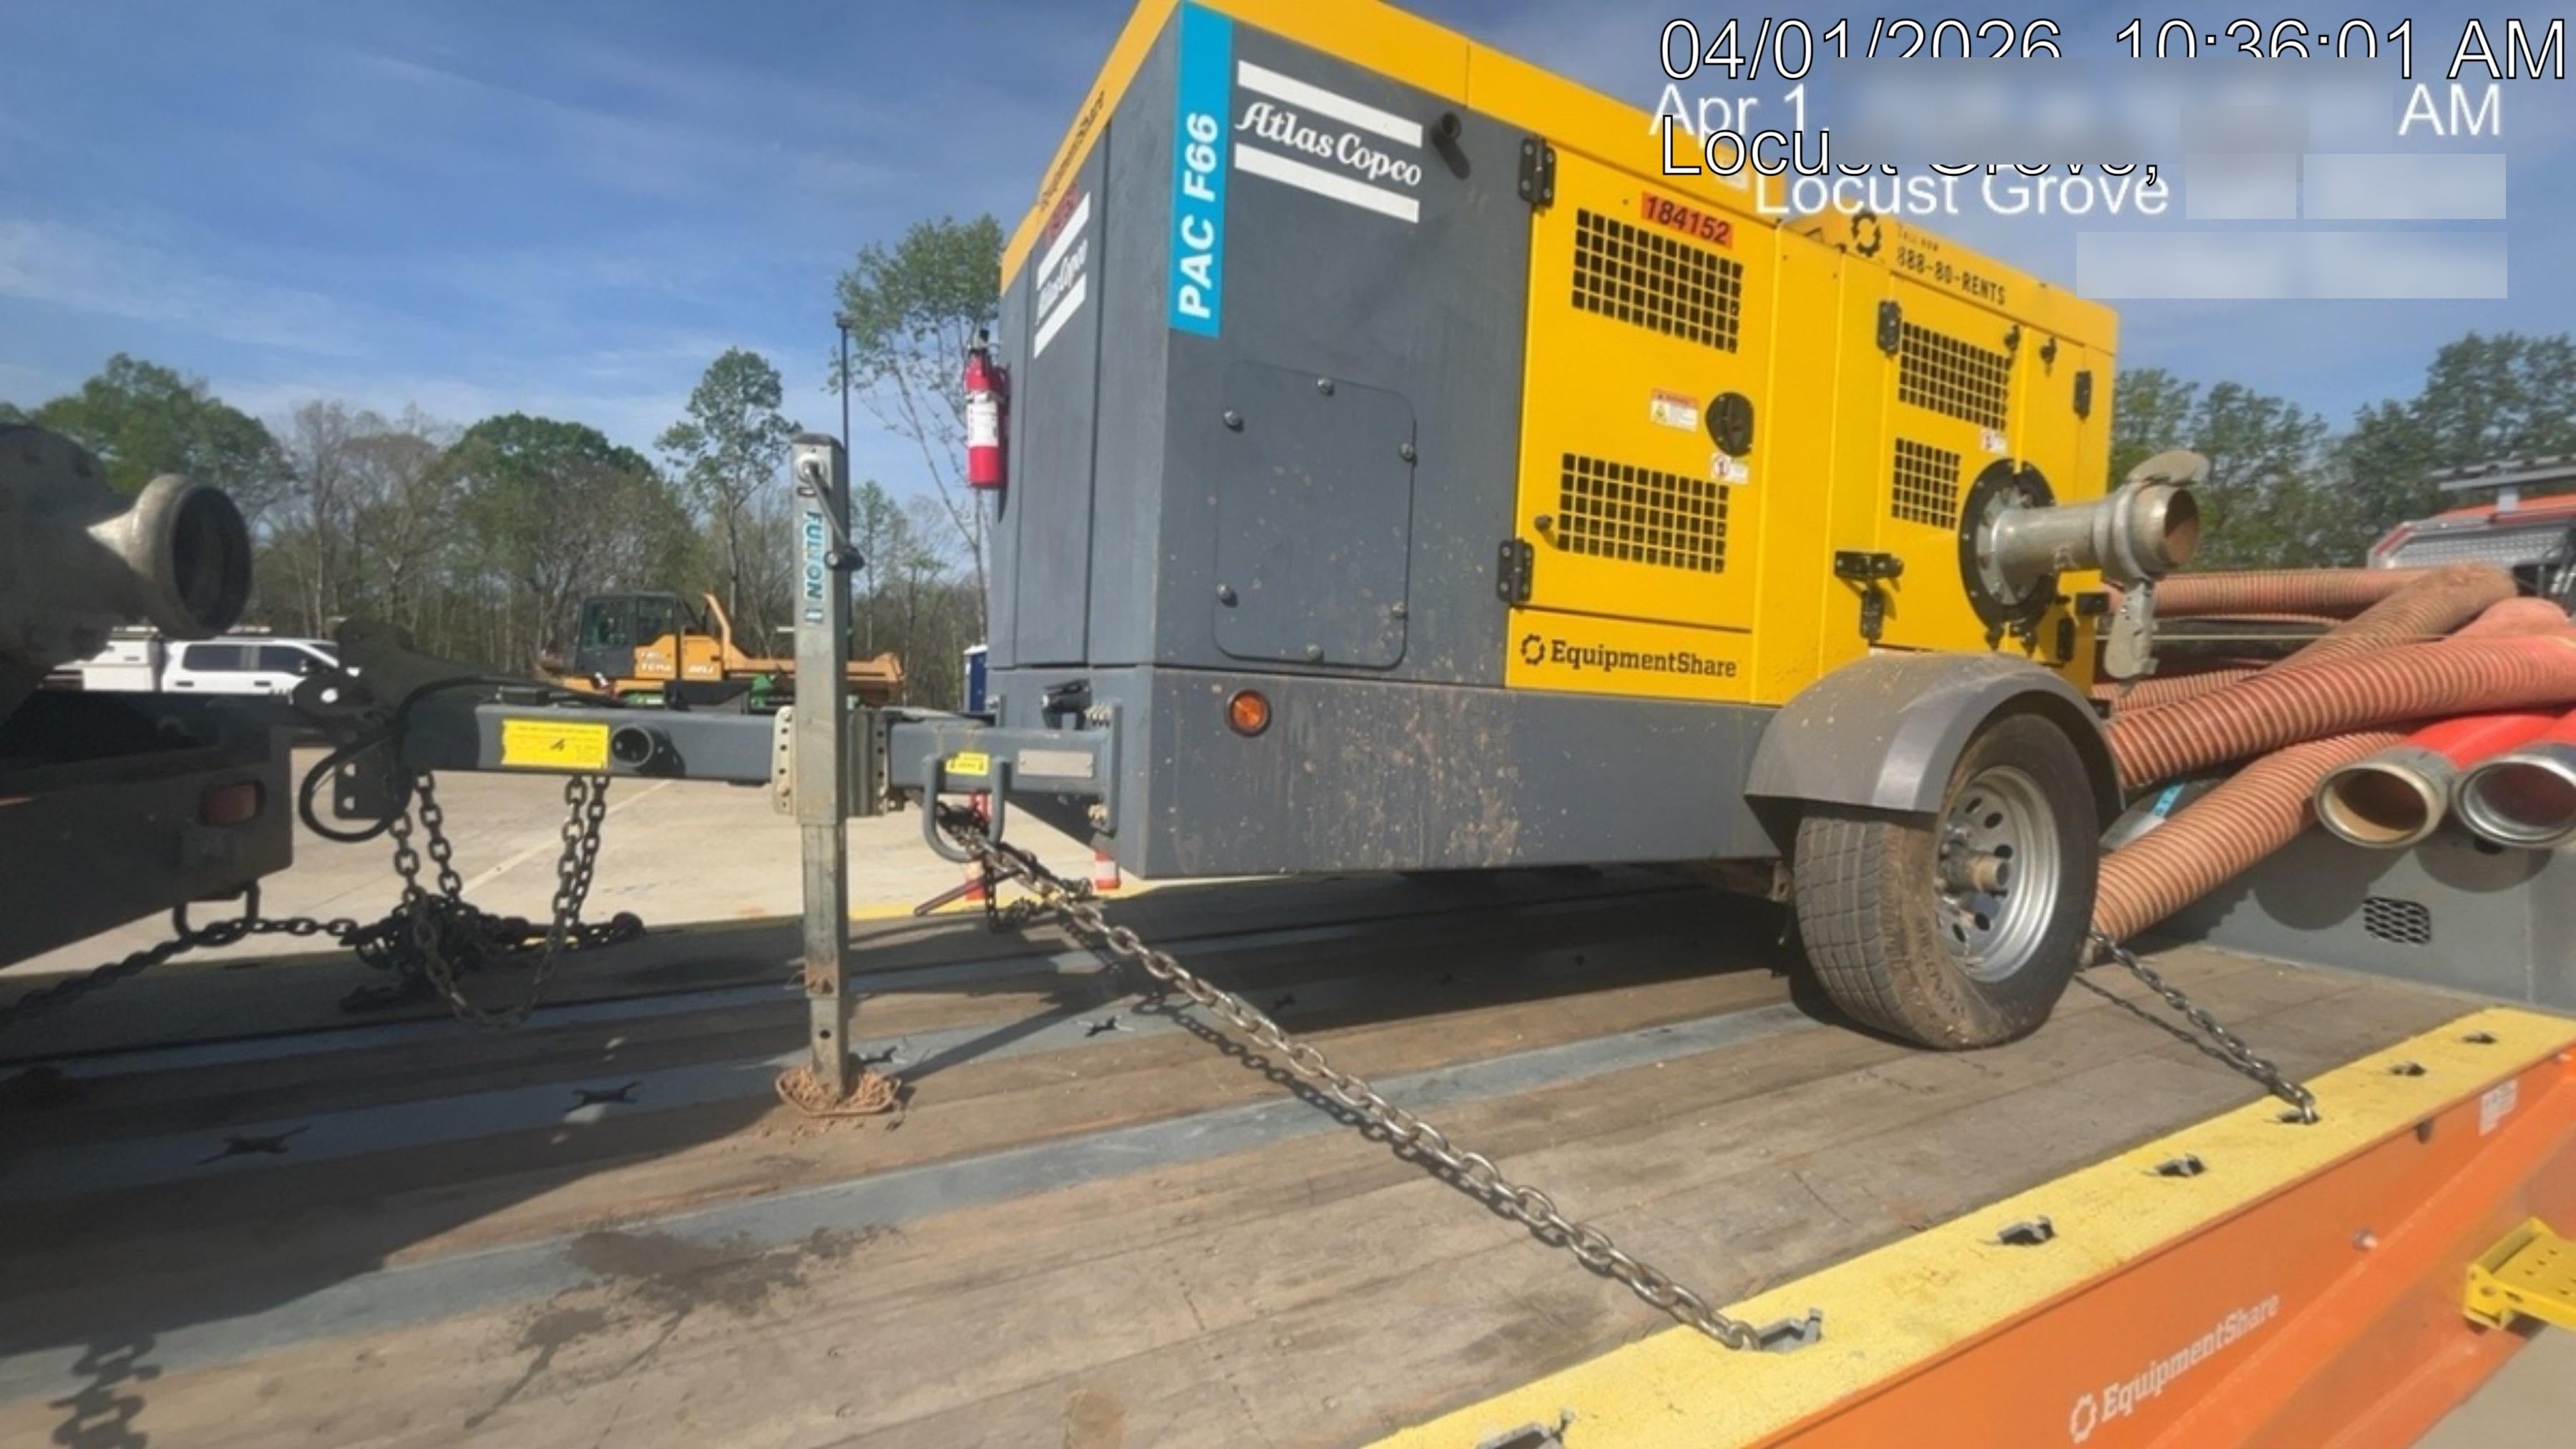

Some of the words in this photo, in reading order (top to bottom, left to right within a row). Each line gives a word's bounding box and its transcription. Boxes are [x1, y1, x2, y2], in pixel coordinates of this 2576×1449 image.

[1183, 112, 1218, 203] F66
[1647, 195, 1730, 245] 184152
[1178, 214, 1214, 319] PAC
[1897, 245, 2006, 306] 888-80-RENTS
[806, 509, 823, 599] FULTON
[1551, 639, 1737, 678] EquipmentShare
[2101, 1294, 2280, 1423] EquipmentShare
